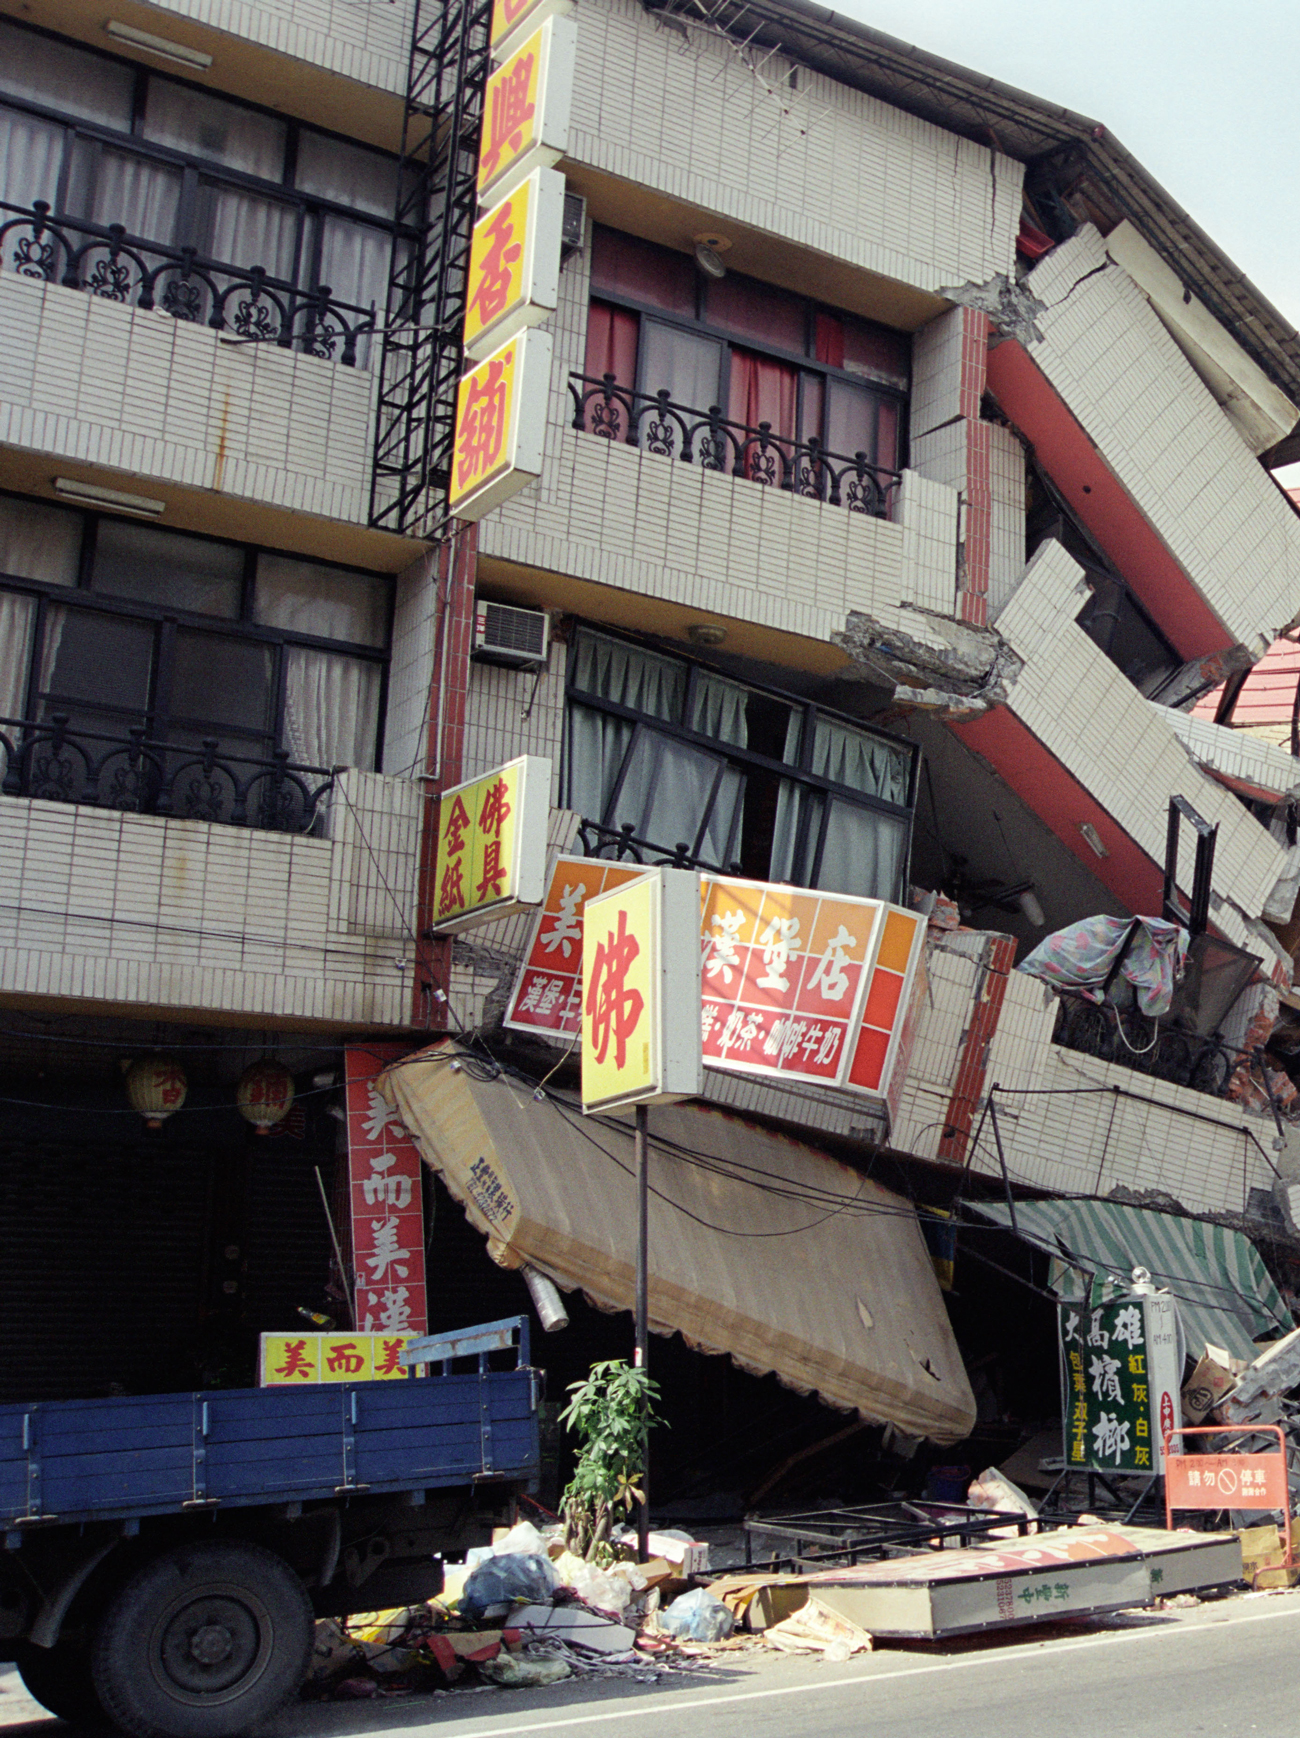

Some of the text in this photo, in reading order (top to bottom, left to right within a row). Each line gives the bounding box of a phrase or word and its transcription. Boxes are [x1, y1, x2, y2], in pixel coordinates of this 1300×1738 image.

[438, 794, 471, 917] 金紙
[476, 777, 511, 903] 佛具
[586, 910, 644, 1070] 佛
[274, 1338, 407, 1379] 美而美
[1188, 1469, 1267, 1486] 請勿 停車
